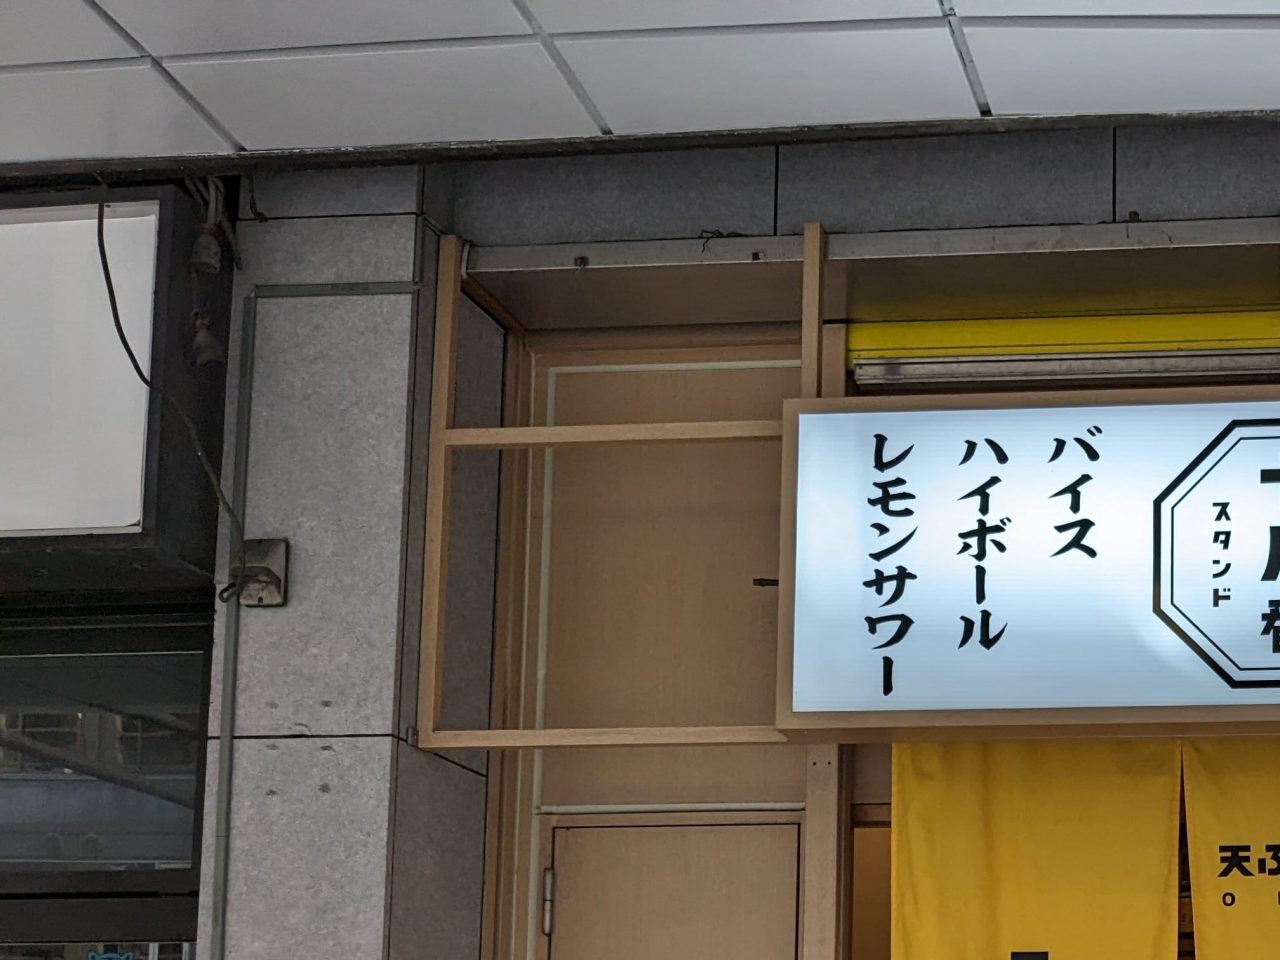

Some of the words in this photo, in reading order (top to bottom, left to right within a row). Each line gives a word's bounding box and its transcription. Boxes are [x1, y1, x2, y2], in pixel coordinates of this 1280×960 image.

[862, 433, 918, 697] レモンサワー
[957, 438, 1009, 651] ハイボール
[1048, 425, 1103, 560] バイス
[1212, 501, 1232, 608] スタンド
